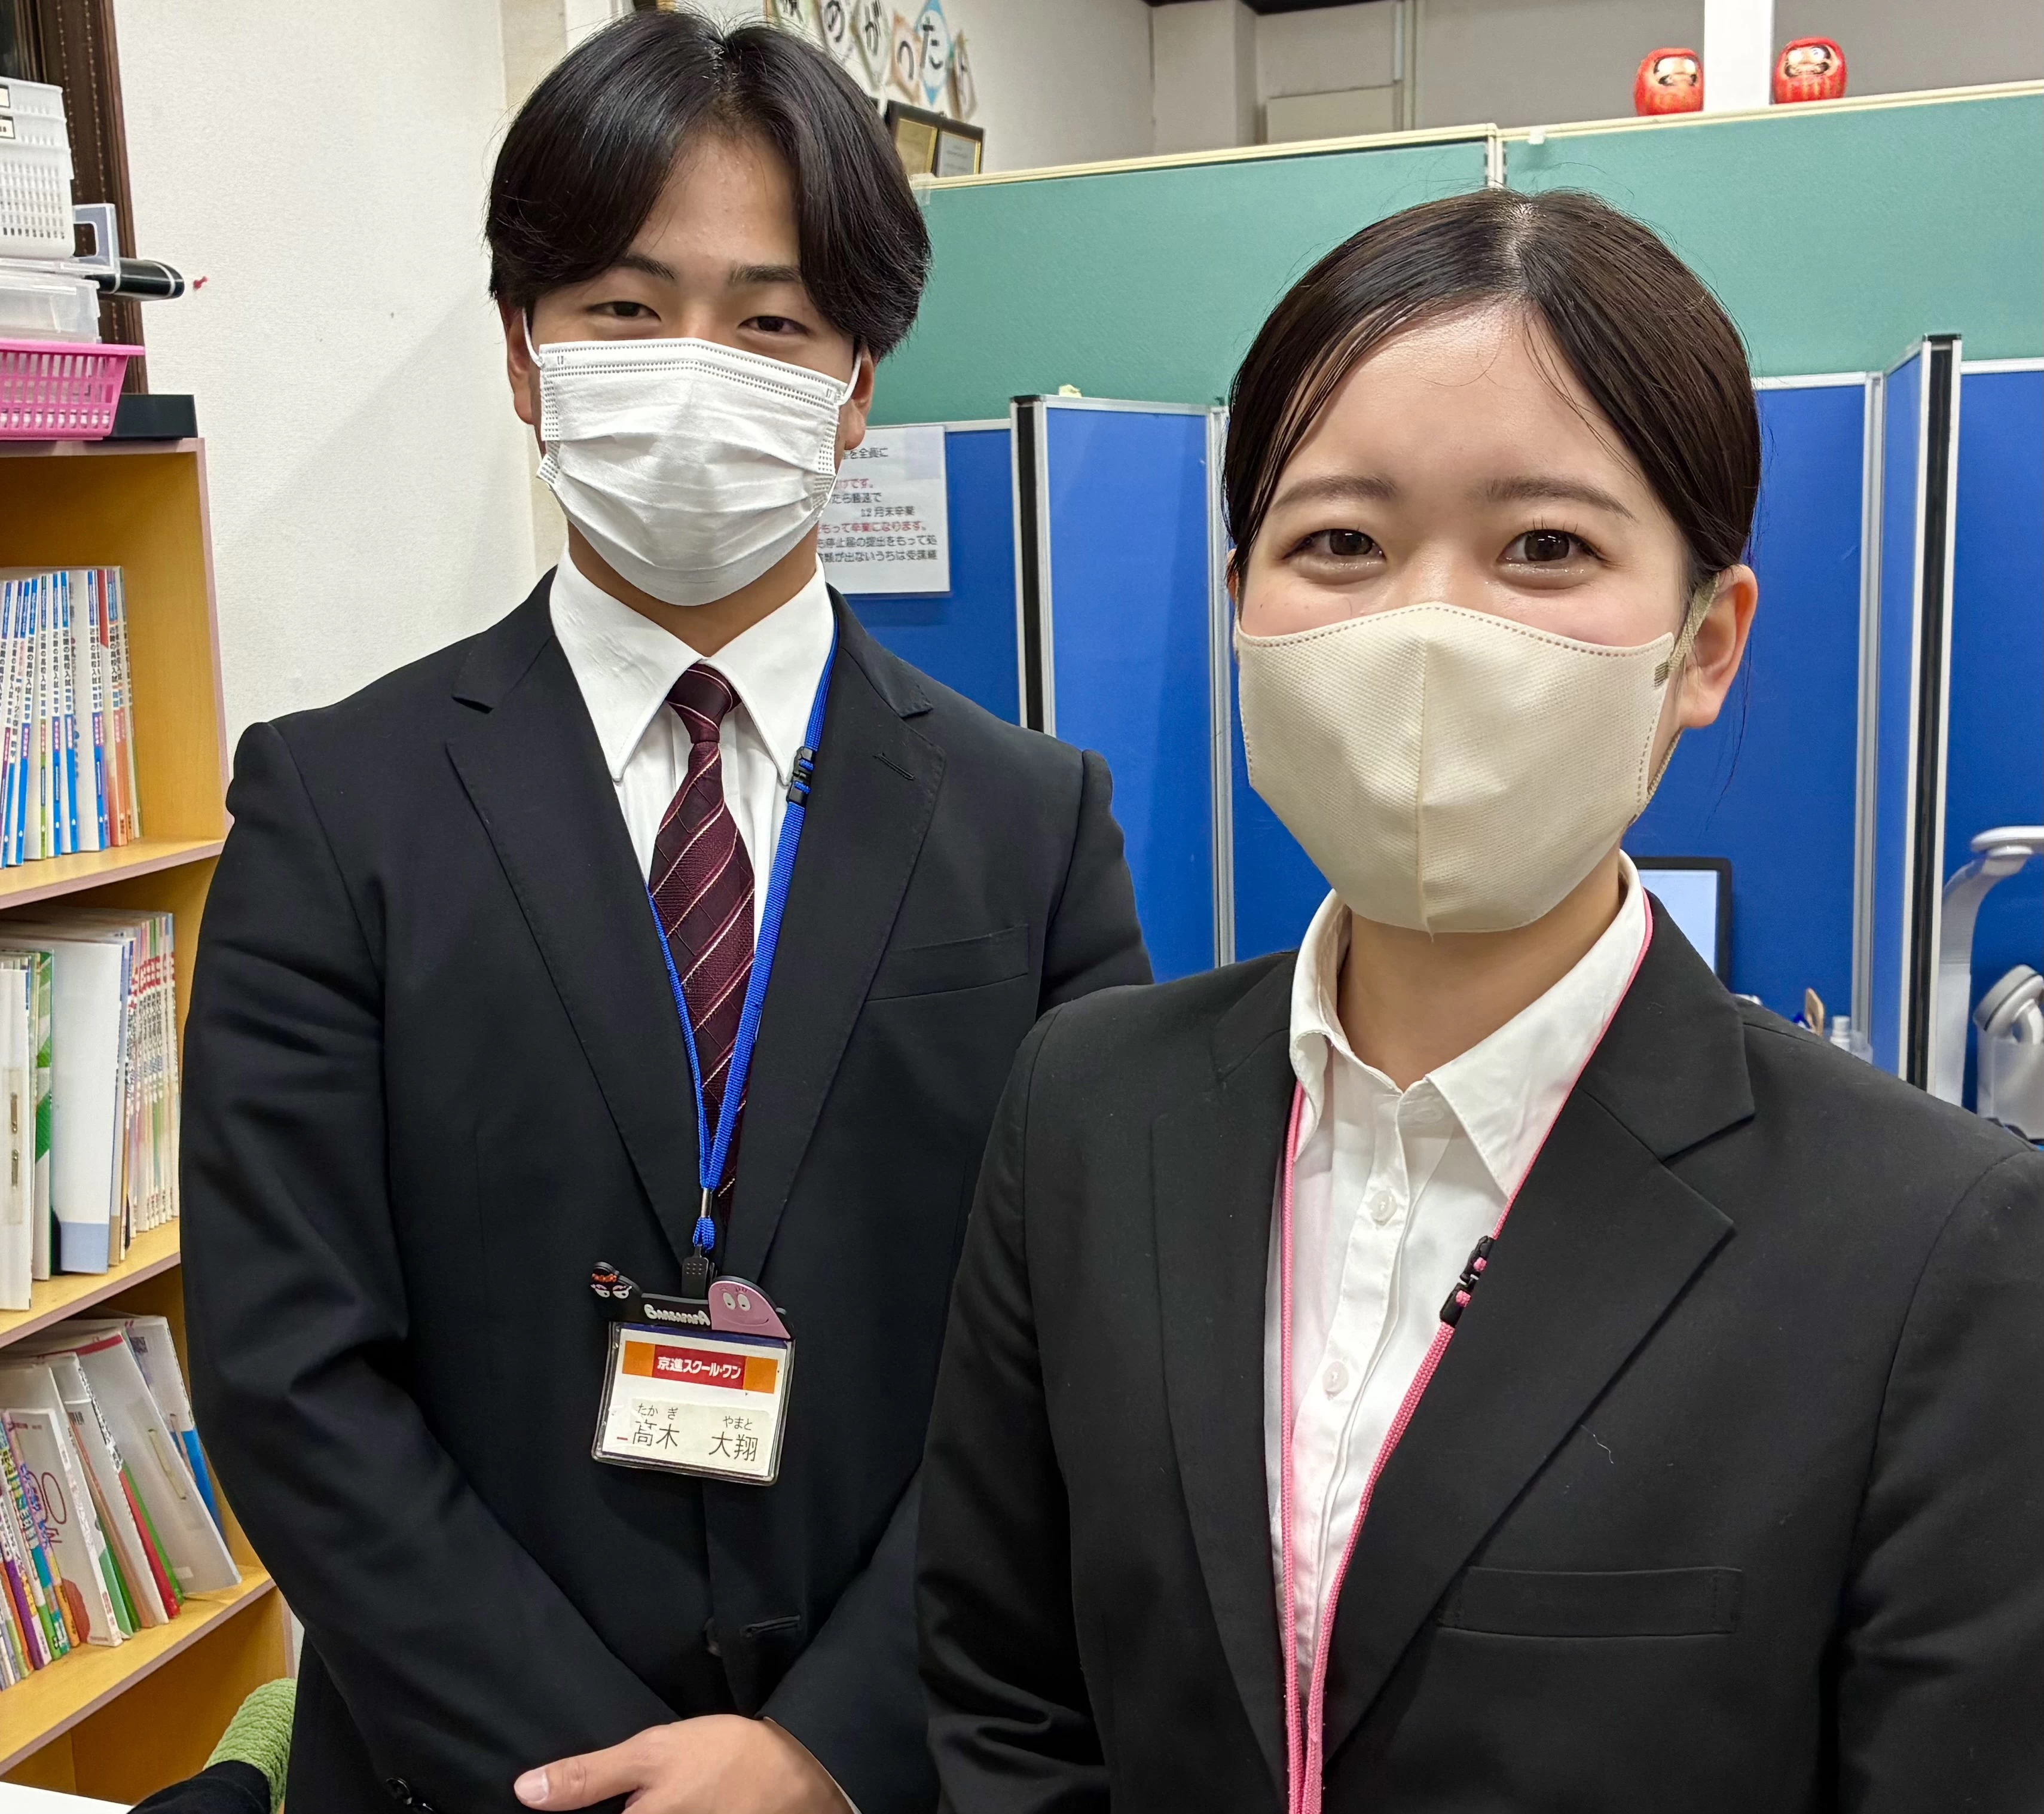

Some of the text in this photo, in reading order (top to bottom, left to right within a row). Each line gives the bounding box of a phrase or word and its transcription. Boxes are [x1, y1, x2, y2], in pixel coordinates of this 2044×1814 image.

[657, 1356, 741, 1379] 京進スクール・ワン
[638, 1403, 753, 1431] たか ぎ やまと
[708, 1431, 758, 1462] 大翔
